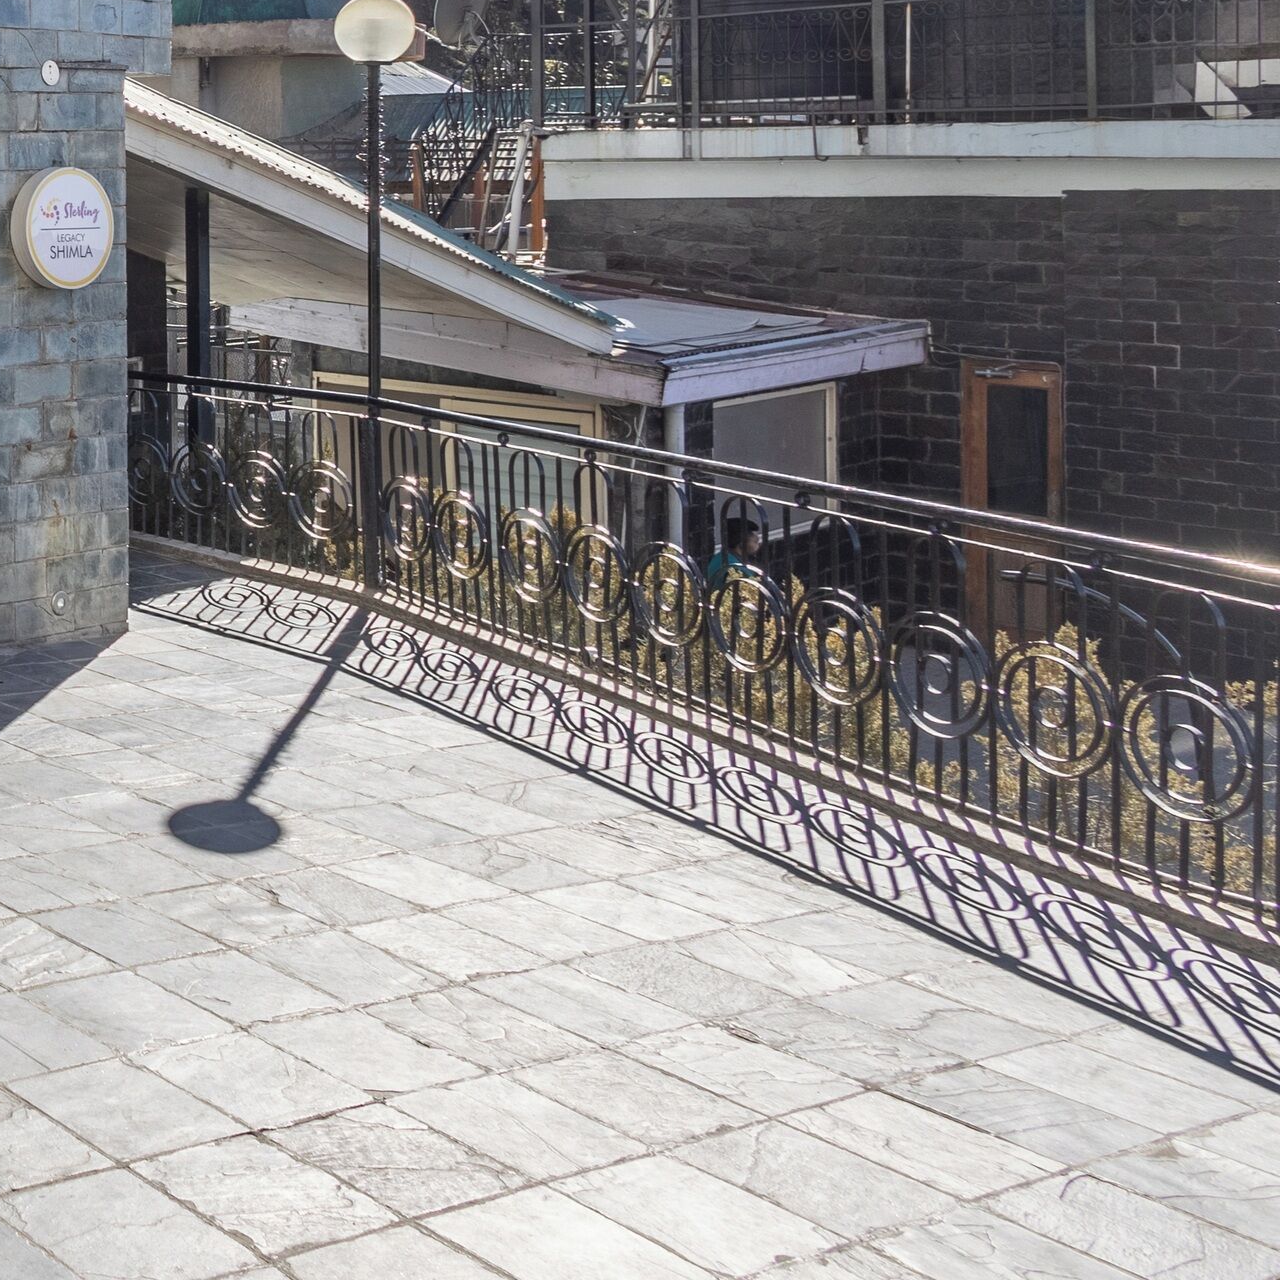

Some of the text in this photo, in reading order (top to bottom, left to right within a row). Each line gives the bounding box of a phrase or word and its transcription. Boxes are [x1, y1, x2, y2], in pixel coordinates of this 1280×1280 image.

[64, 200, 100, 224] Sterling
[56, 233, 85, 243] LEGACY
[50, 244, 93, 260] SHIMLA
